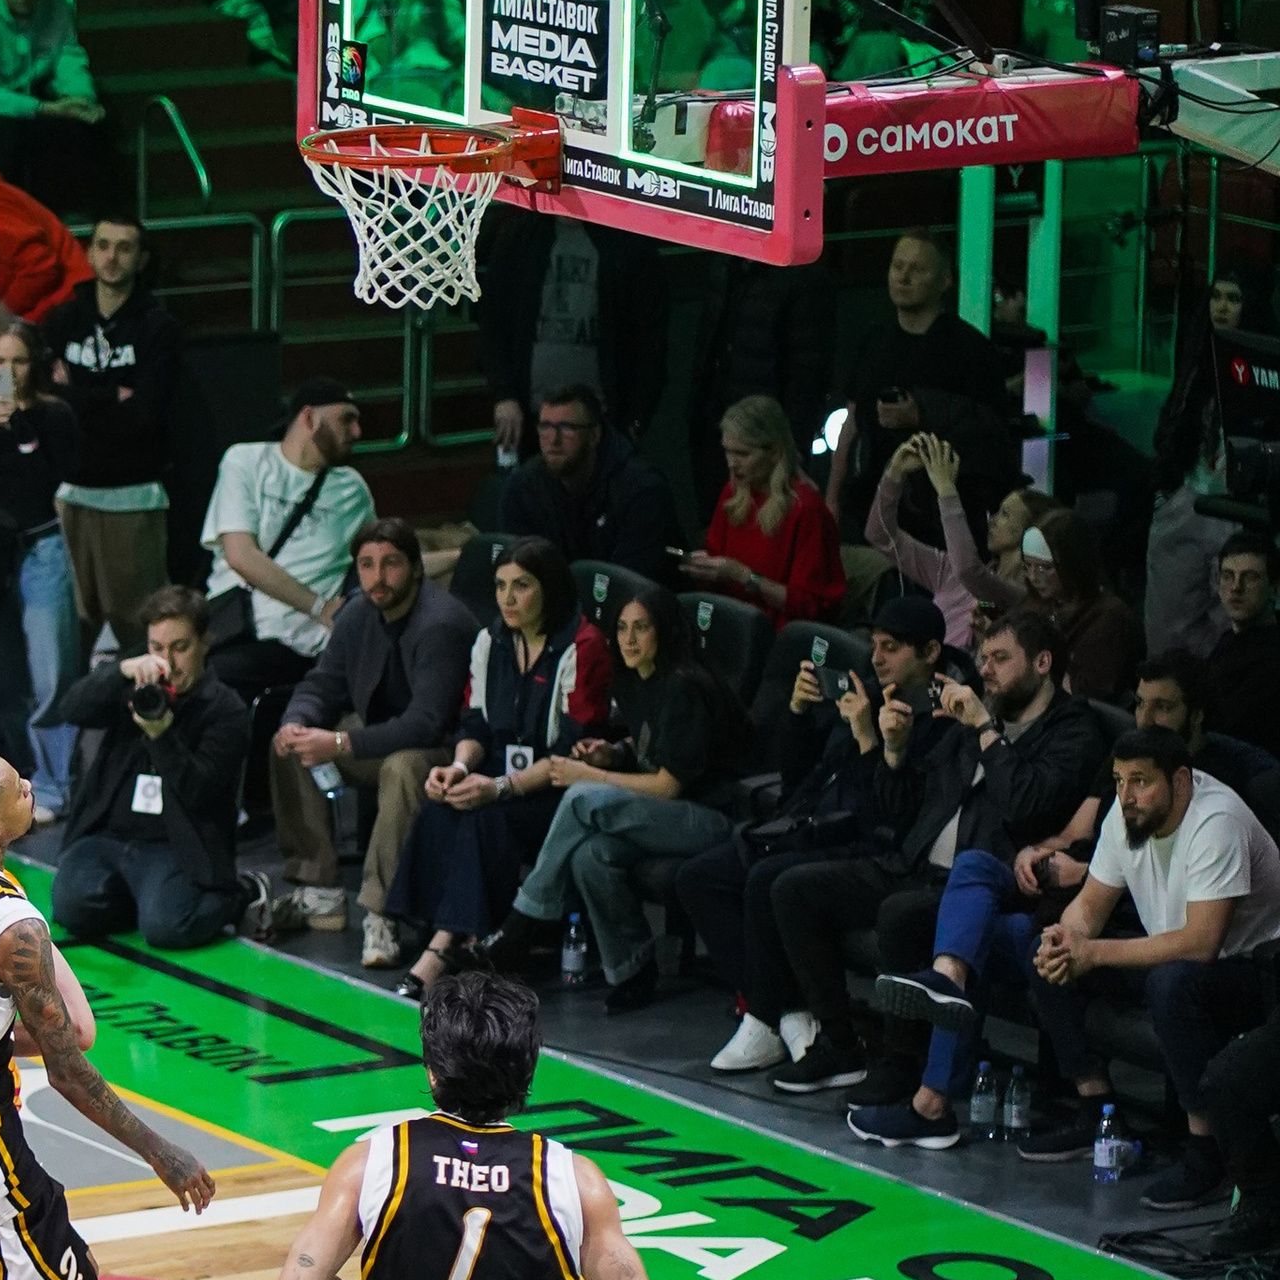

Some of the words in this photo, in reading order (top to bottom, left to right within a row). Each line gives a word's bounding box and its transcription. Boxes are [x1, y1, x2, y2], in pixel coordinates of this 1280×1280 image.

[491, 19, 597, 69] MEDIA
[490, 51, 597, 93] BASKET
[741, 194, 775, 221] СТАВО
[432, 1154, 510, 1193] THEO
